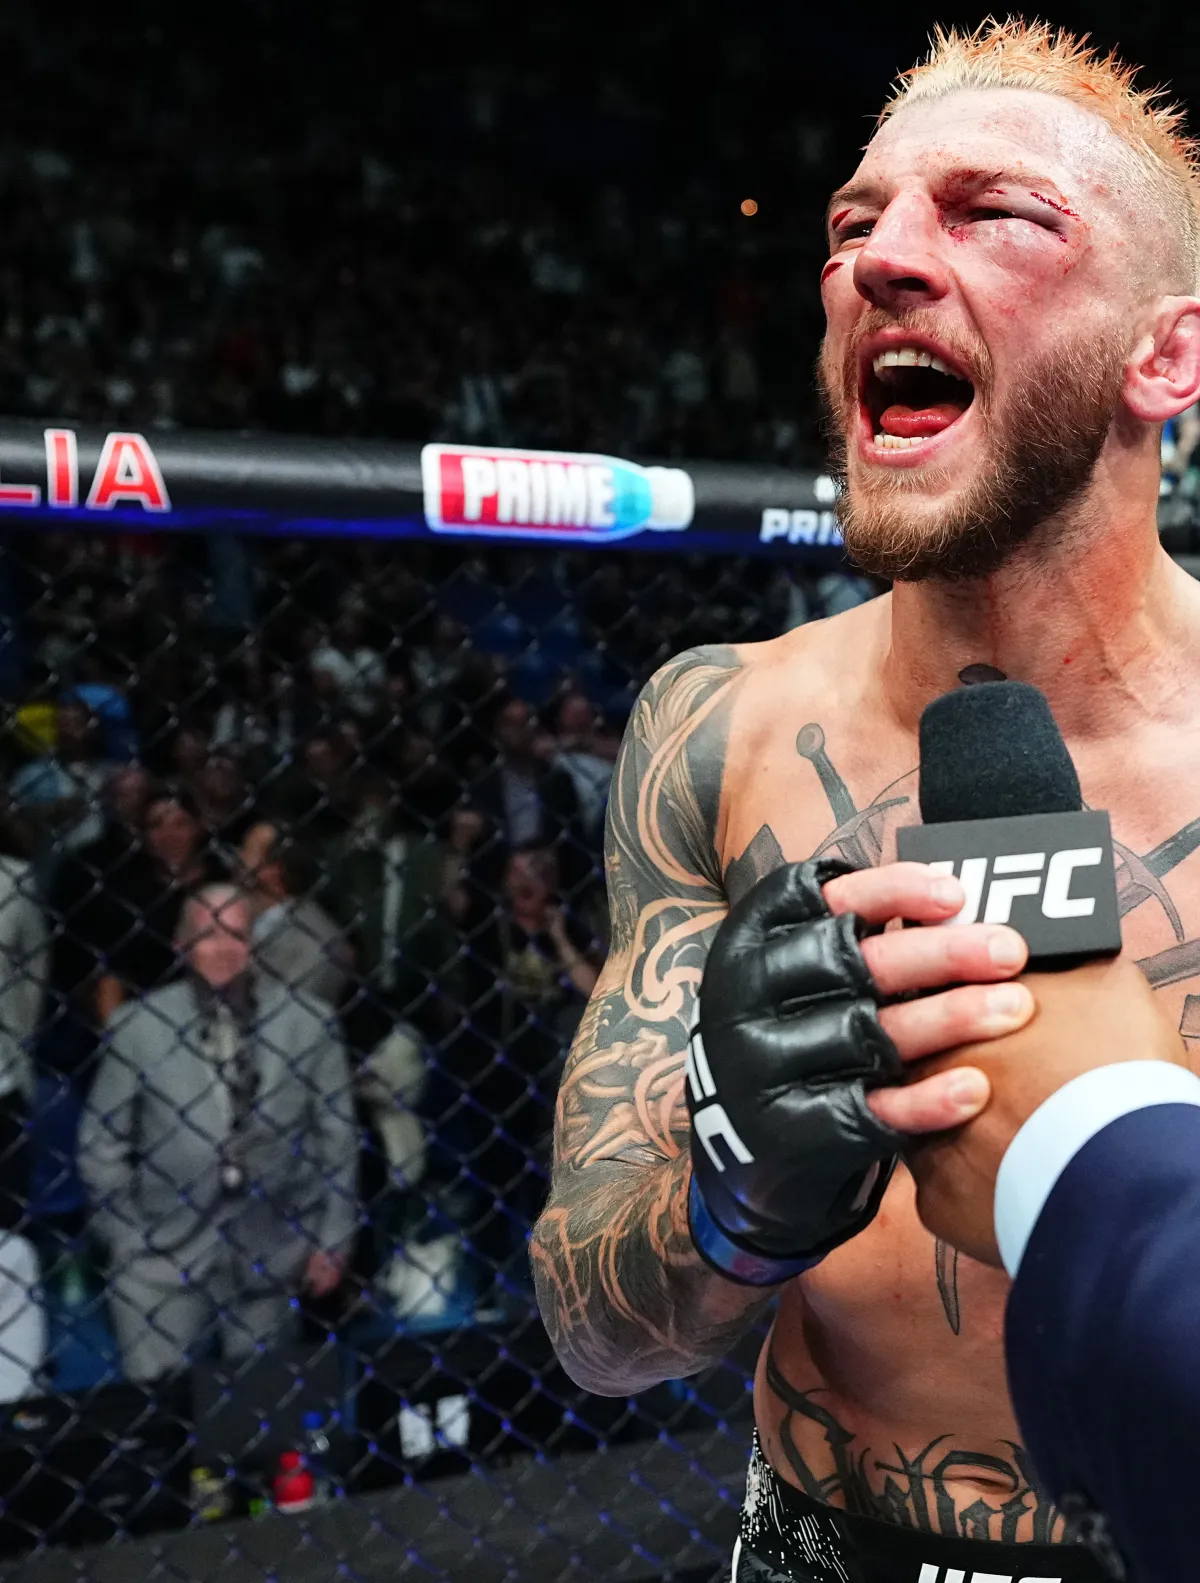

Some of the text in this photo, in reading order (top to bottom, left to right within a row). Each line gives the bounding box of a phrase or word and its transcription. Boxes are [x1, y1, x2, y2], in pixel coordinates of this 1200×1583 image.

[460, 456, 615, 528] PRIME
[759, 507, 843, 546] PRI
[684, 997, 755, 1172] FC
